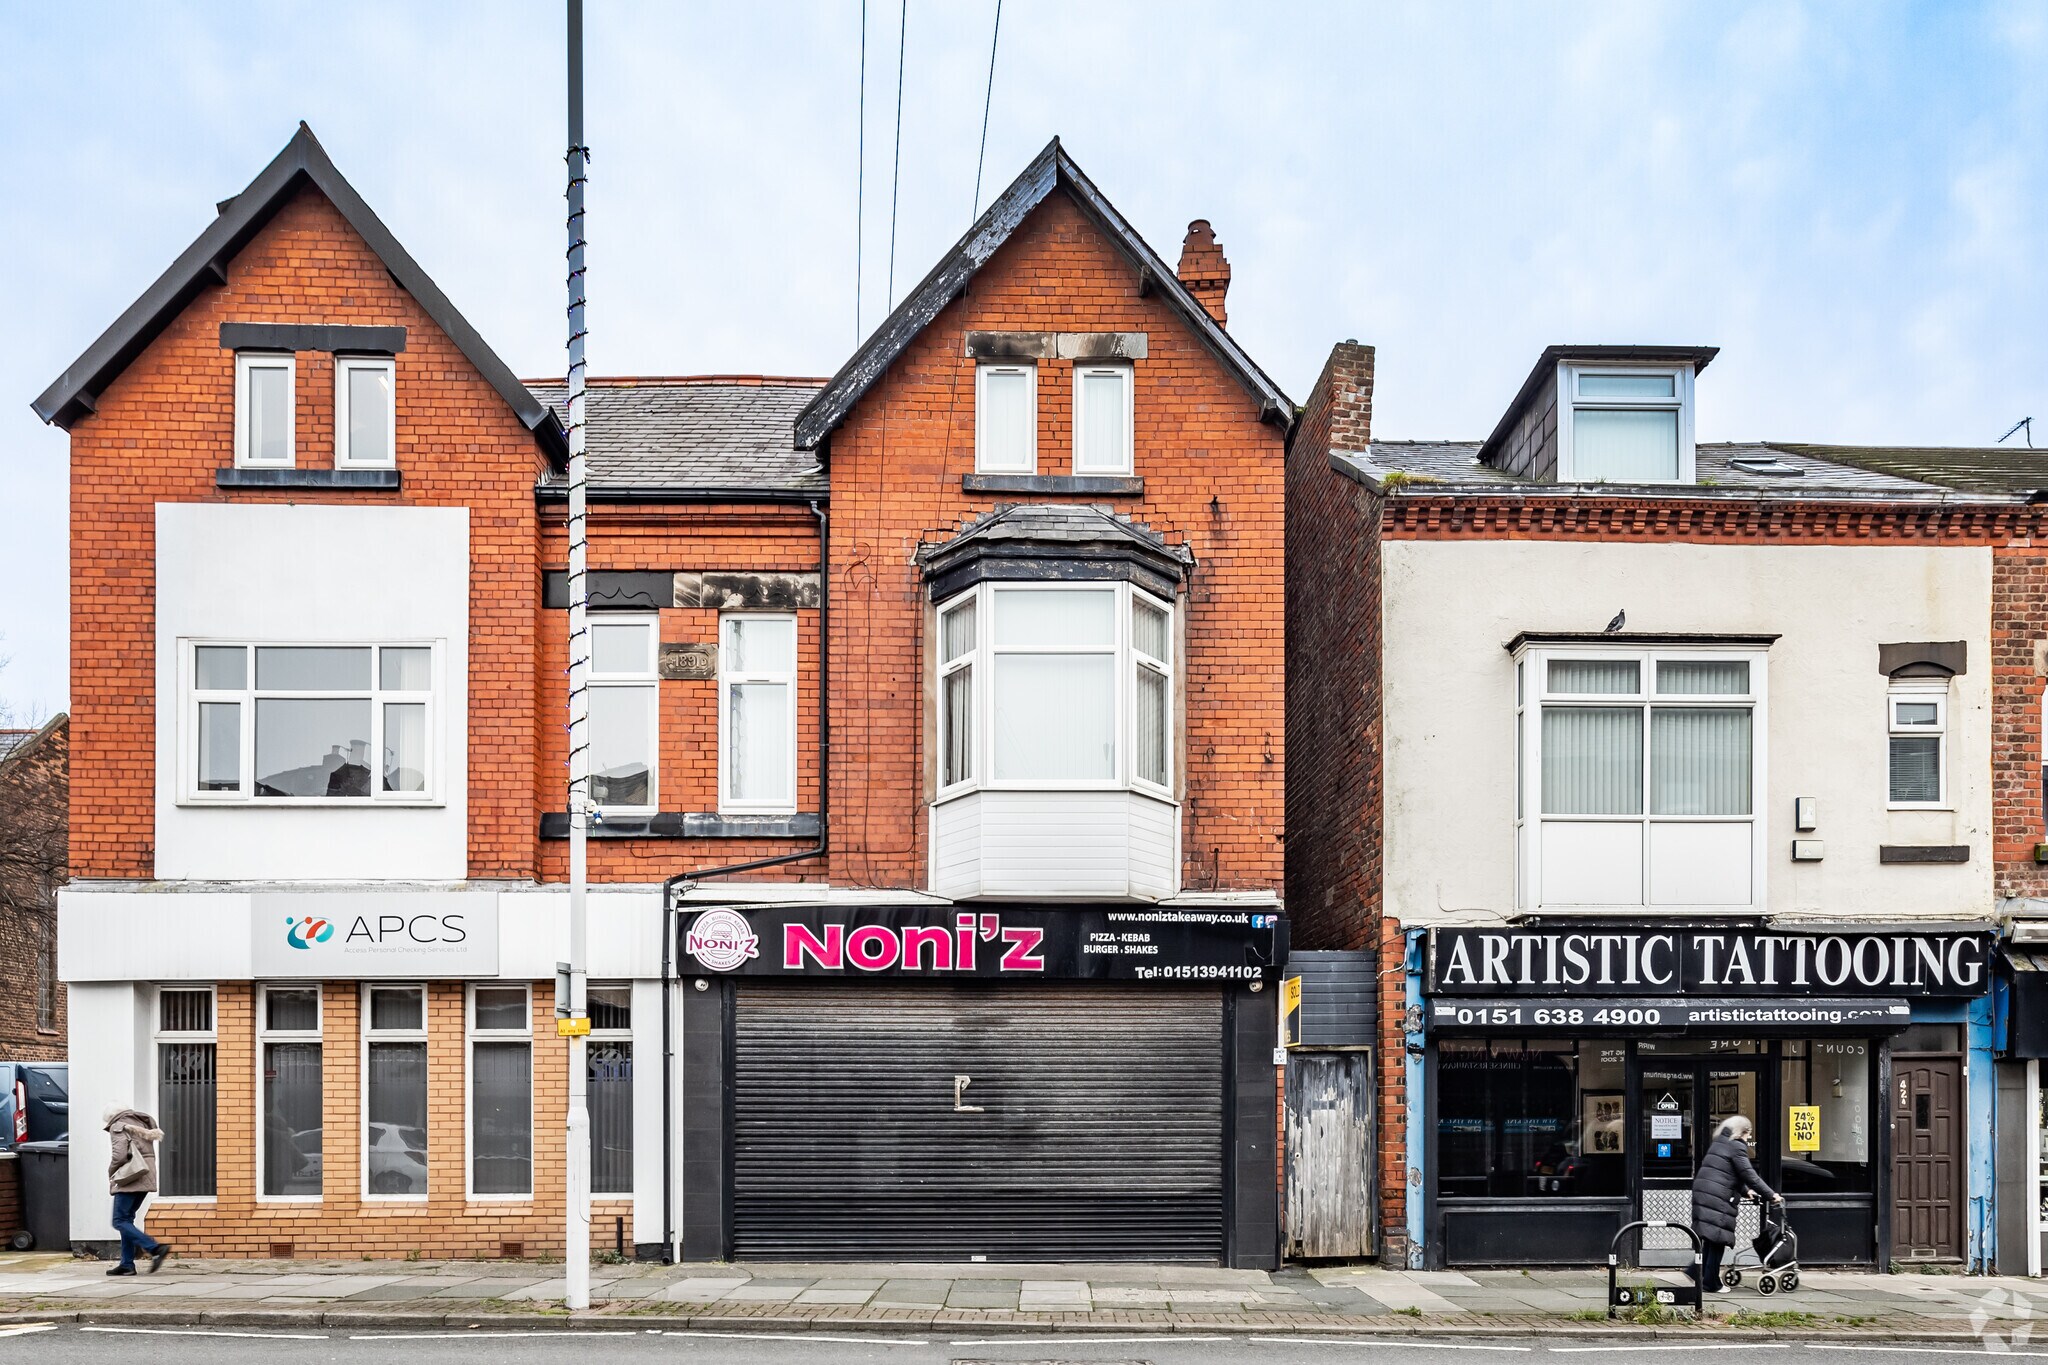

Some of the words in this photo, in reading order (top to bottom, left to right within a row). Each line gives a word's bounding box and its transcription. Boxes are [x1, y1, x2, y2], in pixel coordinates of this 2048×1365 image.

[1108, 911, 1248, 924] www.noniztakeaway.co.uk
[345, 914, 466, 943] APCS
[783, 913, 1044, 971] Noni'z
[1090, 932, 1116, 942] PIZZA
[1121, 933, 1151, 942] KEBAB
[398, 946, 426, 955] Checking
[1083, 945, 1119, 954] BURGER
[1124, 945, 1159, 954] SHAKES
[1442, 934, 1674, 985] ARTISTIC
[1693, 935, 1983, 987] TATTOOING
[1457, 1008, 1522, 1025] 0151
[1533, 1008, 1585, 1025] 638
[1592, 1008, 1661, 1025] 4900
[1794, 1112, 1815, 1121] 74%
[1794, 1122, 1814, 1131] SAY
